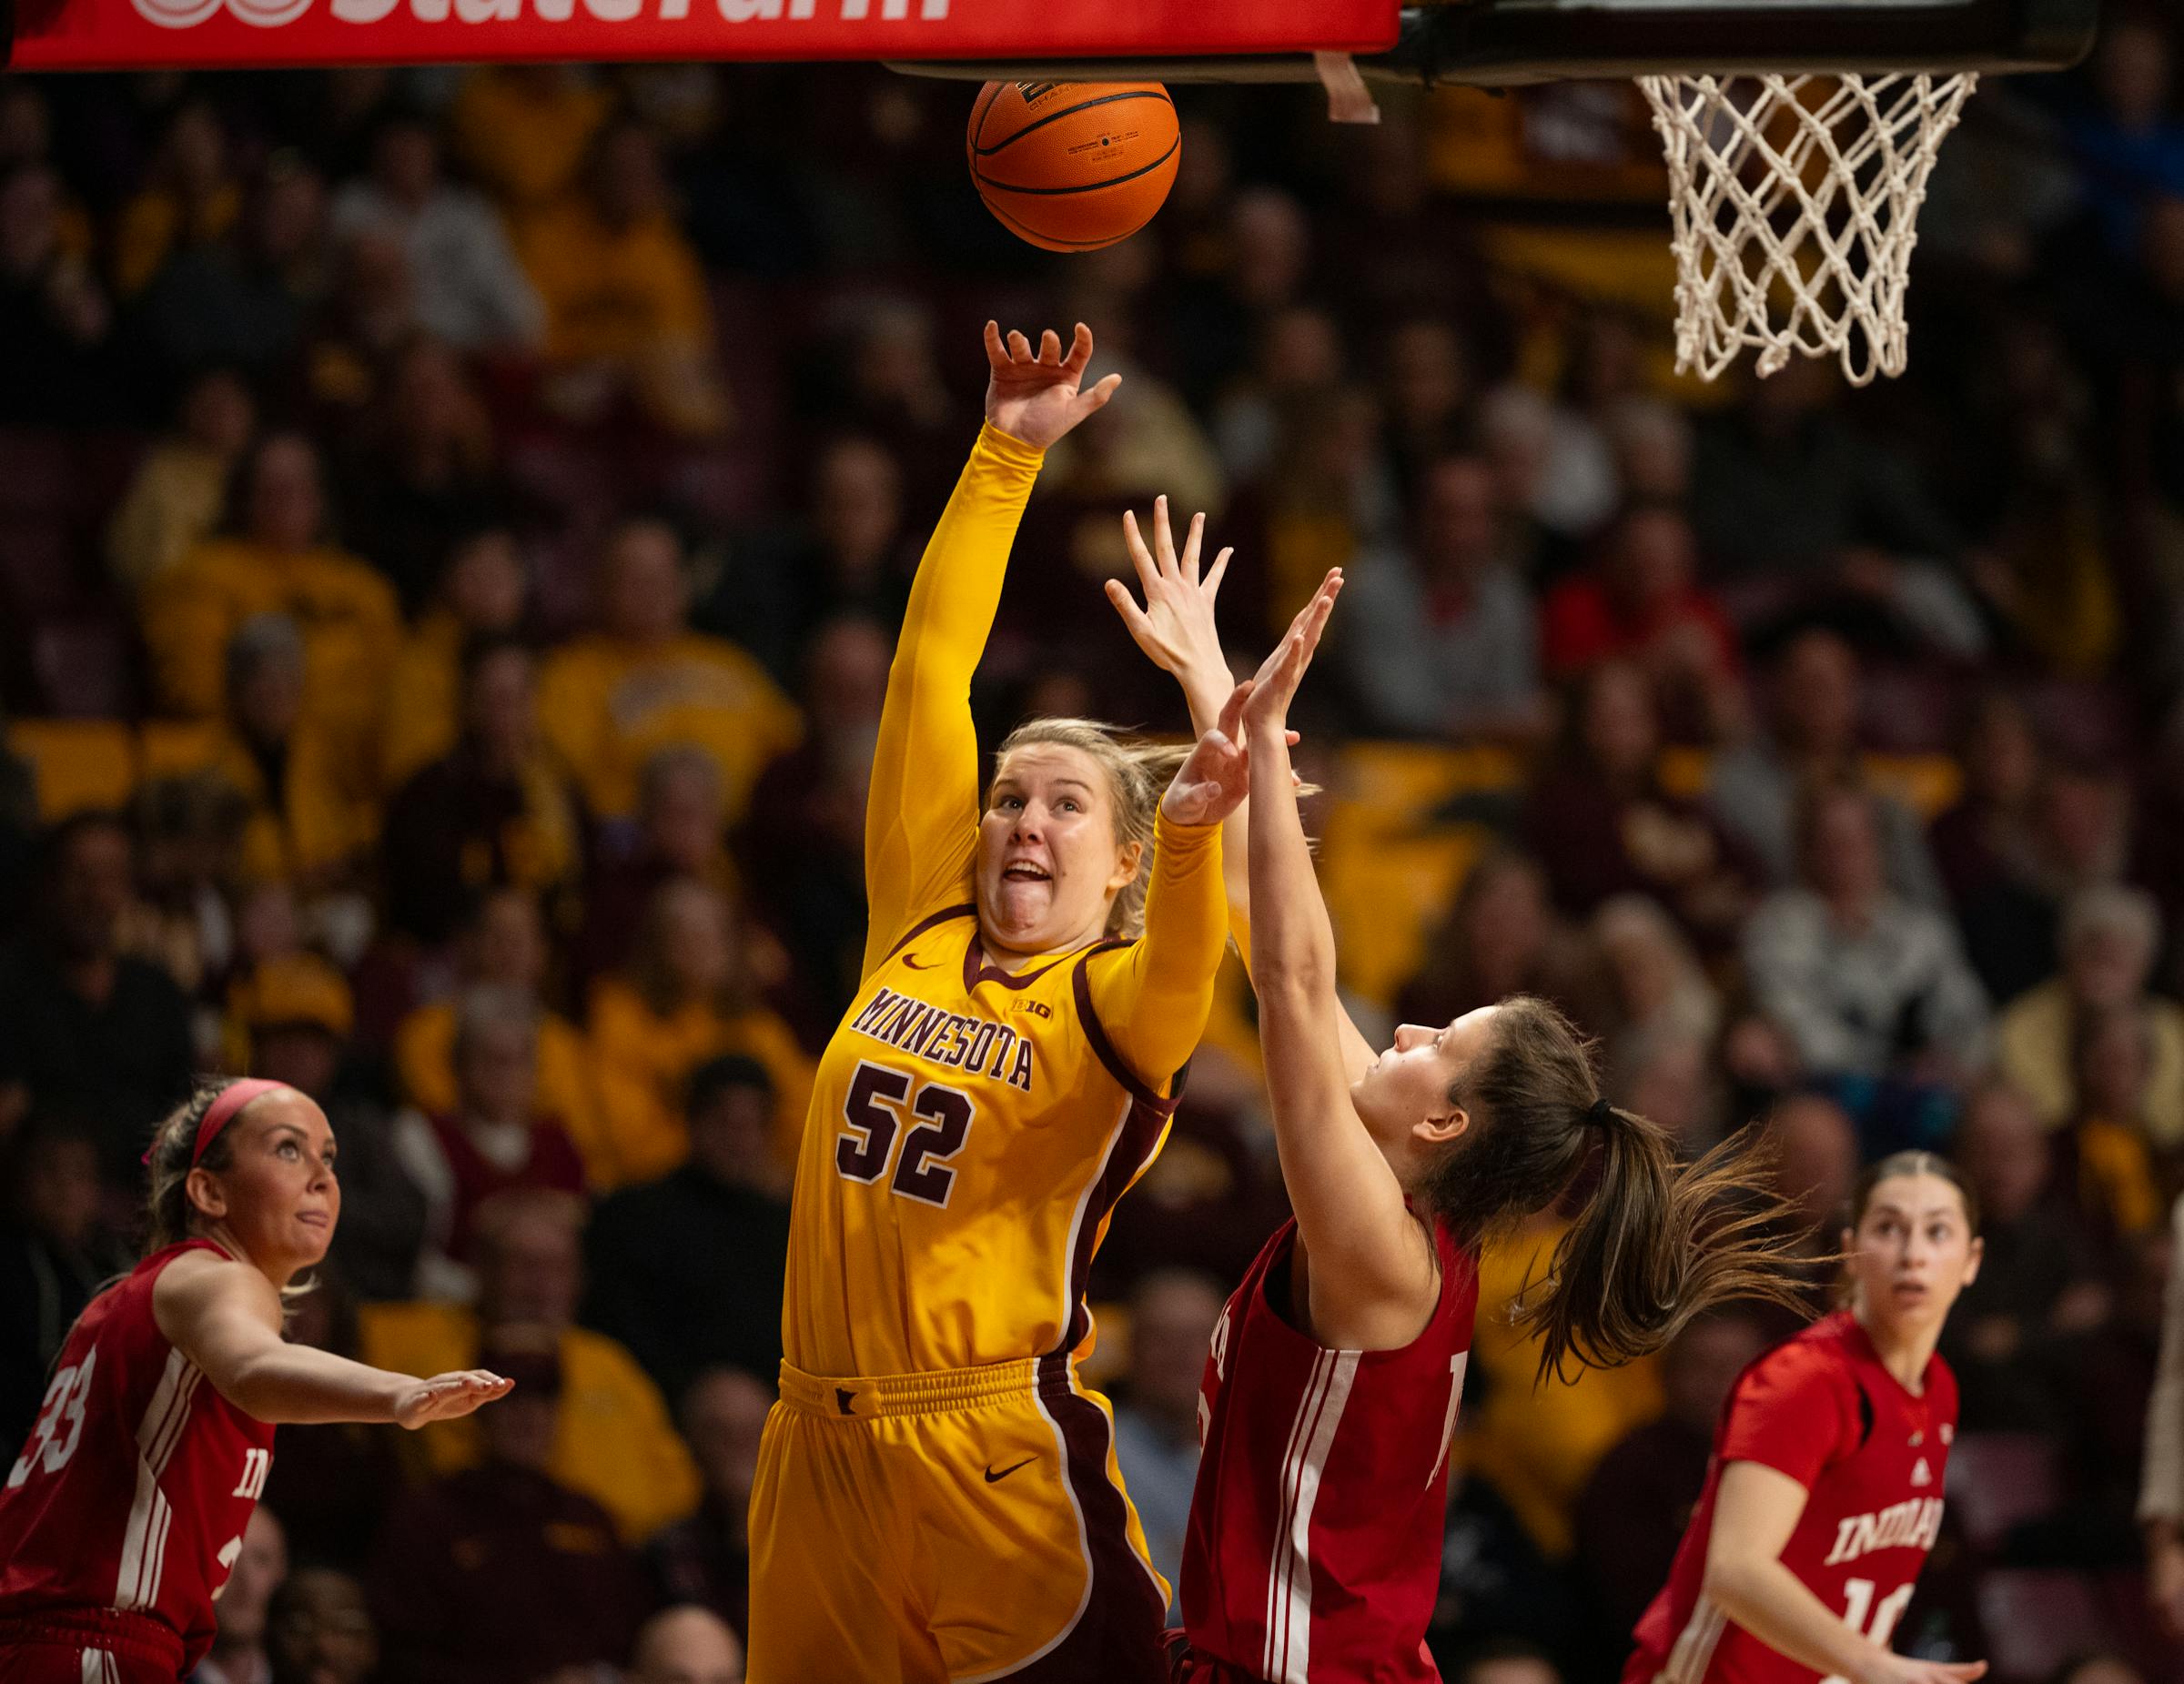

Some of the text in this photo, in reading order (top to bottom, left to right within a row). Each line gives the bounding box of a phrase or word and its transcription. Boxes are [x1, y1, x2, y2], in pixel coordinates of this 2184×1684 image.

[849, 986, 1034, 1092] MINNESOTA
[835, 1058, 976, 1209] 52
[7, 1344, 97, 1489] 33
